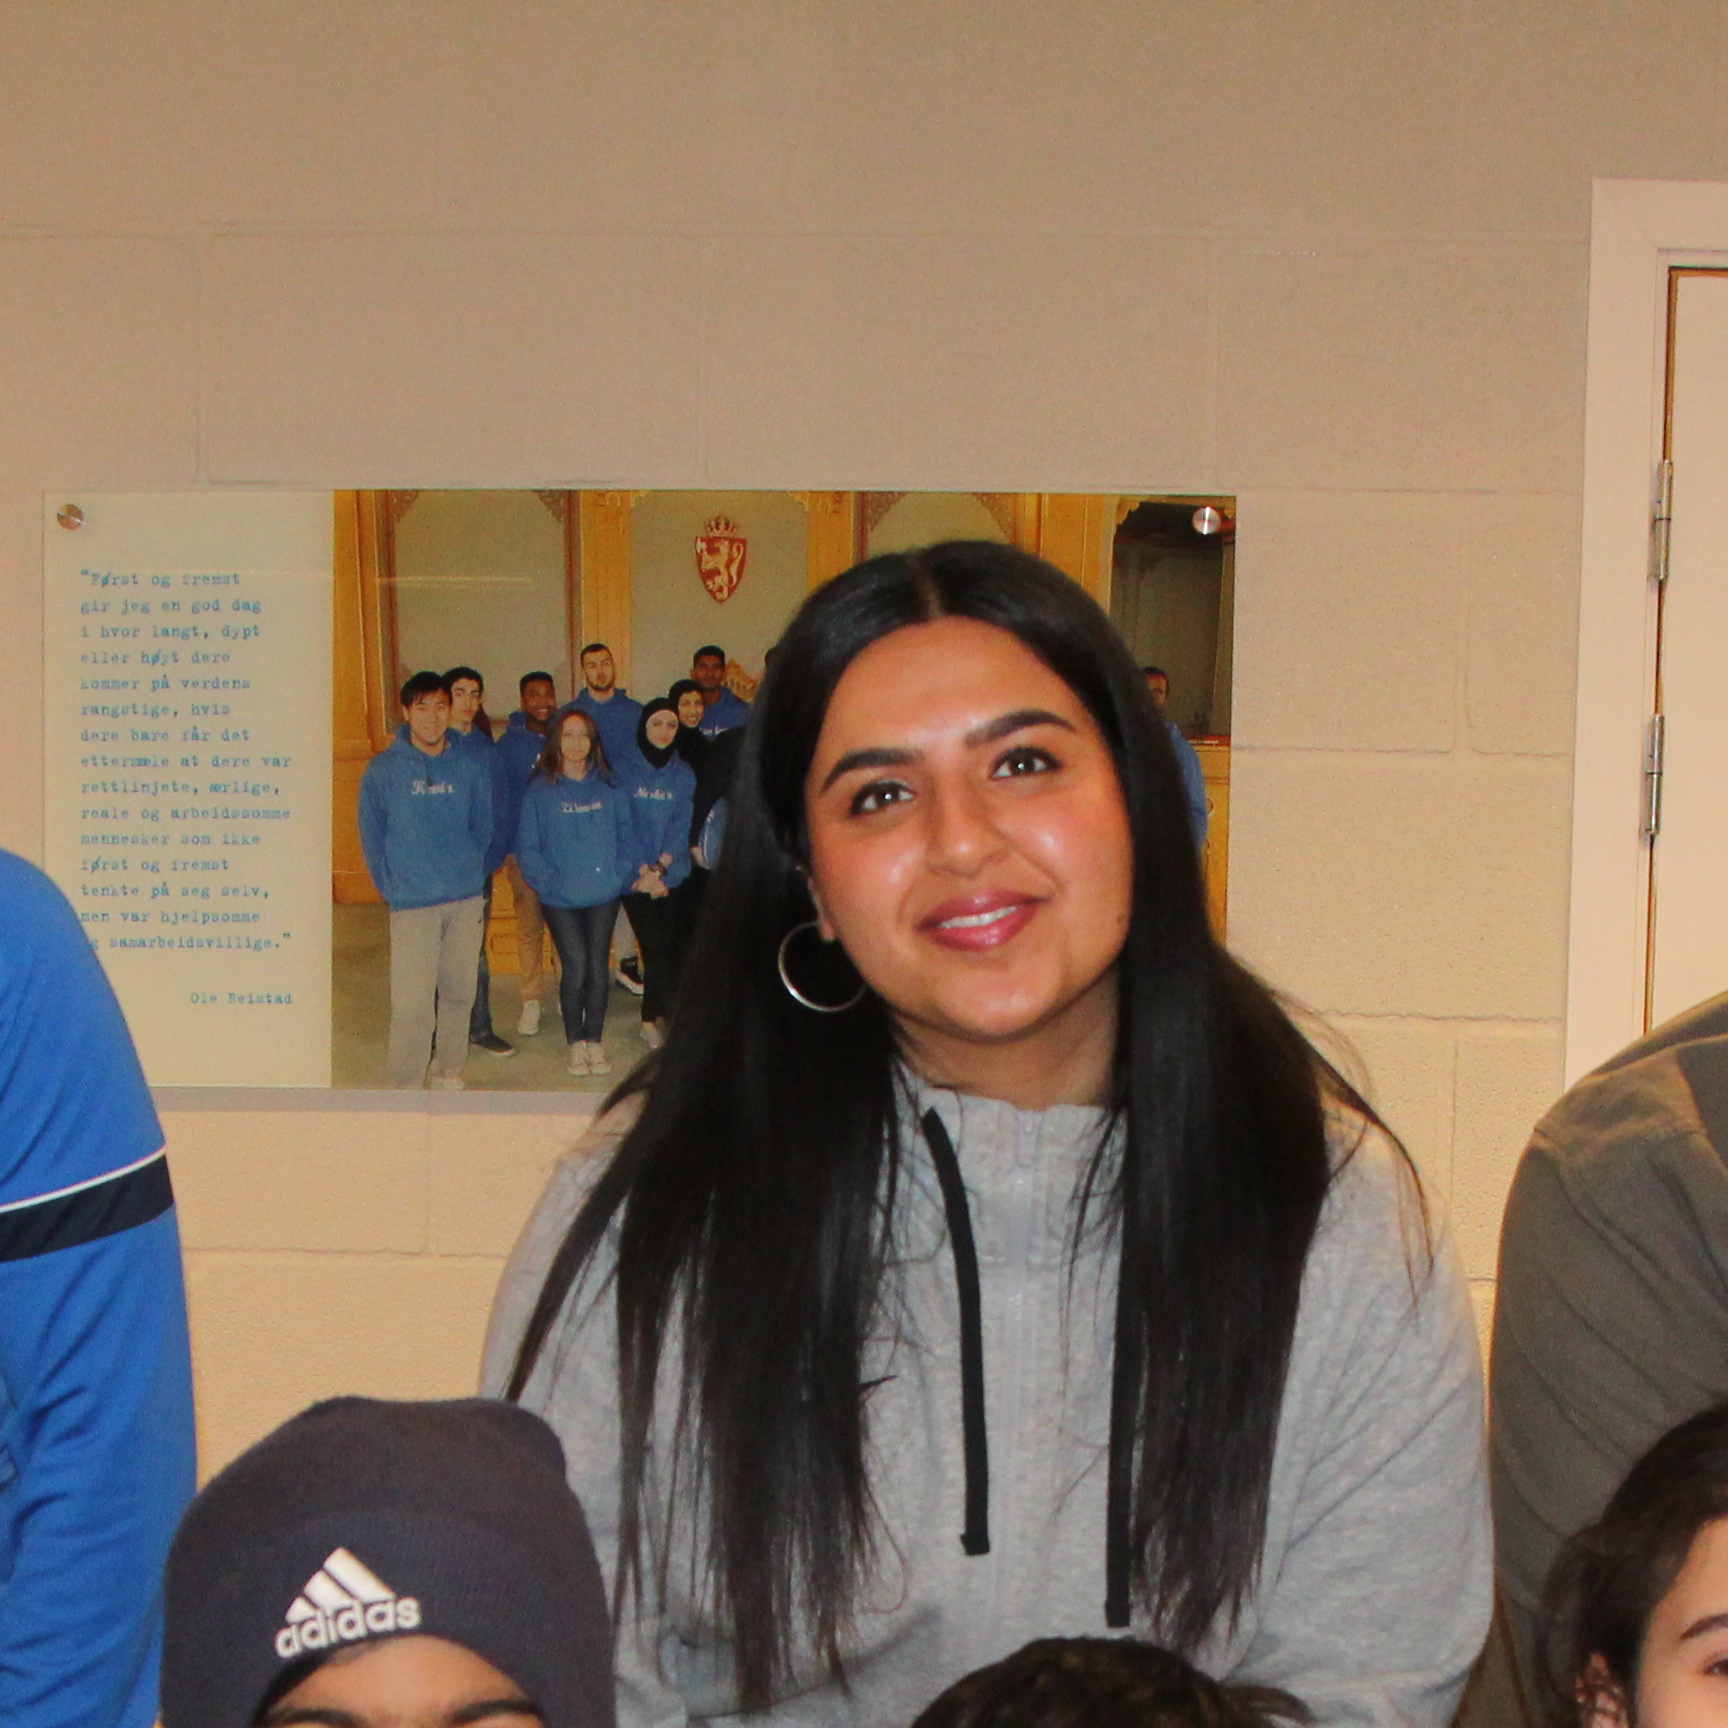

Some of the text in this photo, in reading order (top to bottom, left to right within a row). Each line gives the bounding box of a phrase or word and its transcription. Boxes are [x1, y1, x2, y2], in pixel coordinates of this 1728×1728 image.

[151, 575, 171, 588] og
[183, 573, 240, 585] fremst
[80, 599, 262, 615] gir jeg en god dag
[82, 624, 261, 640] i hvor langt, dypt
[81, 649, 230, 666] eller høyt dere
[81, 673, 250, 692] kommer på verdens
[81, 703, 230, 718] rangstige, hvis
[81, 725, 250, 742] dere bare får det
[180, 754, 199, 767] at
[211, 755, 250, 767] dere
[261, 756, 292, 768] var
[82, 780, 279, 796] rettlinjete, ærlige,
[81, 807, 290, 822] reale og arbeidssomme
[80, 834, 261, 845] mennesker som ikke
[82, 856, 229, 873] først og fremst
[81, 881, 270, 899] tenkte på seg selv,
[79, 911, 260, 926] men var hjelpsomme
[275, 1597, 421, 1658] adidas
